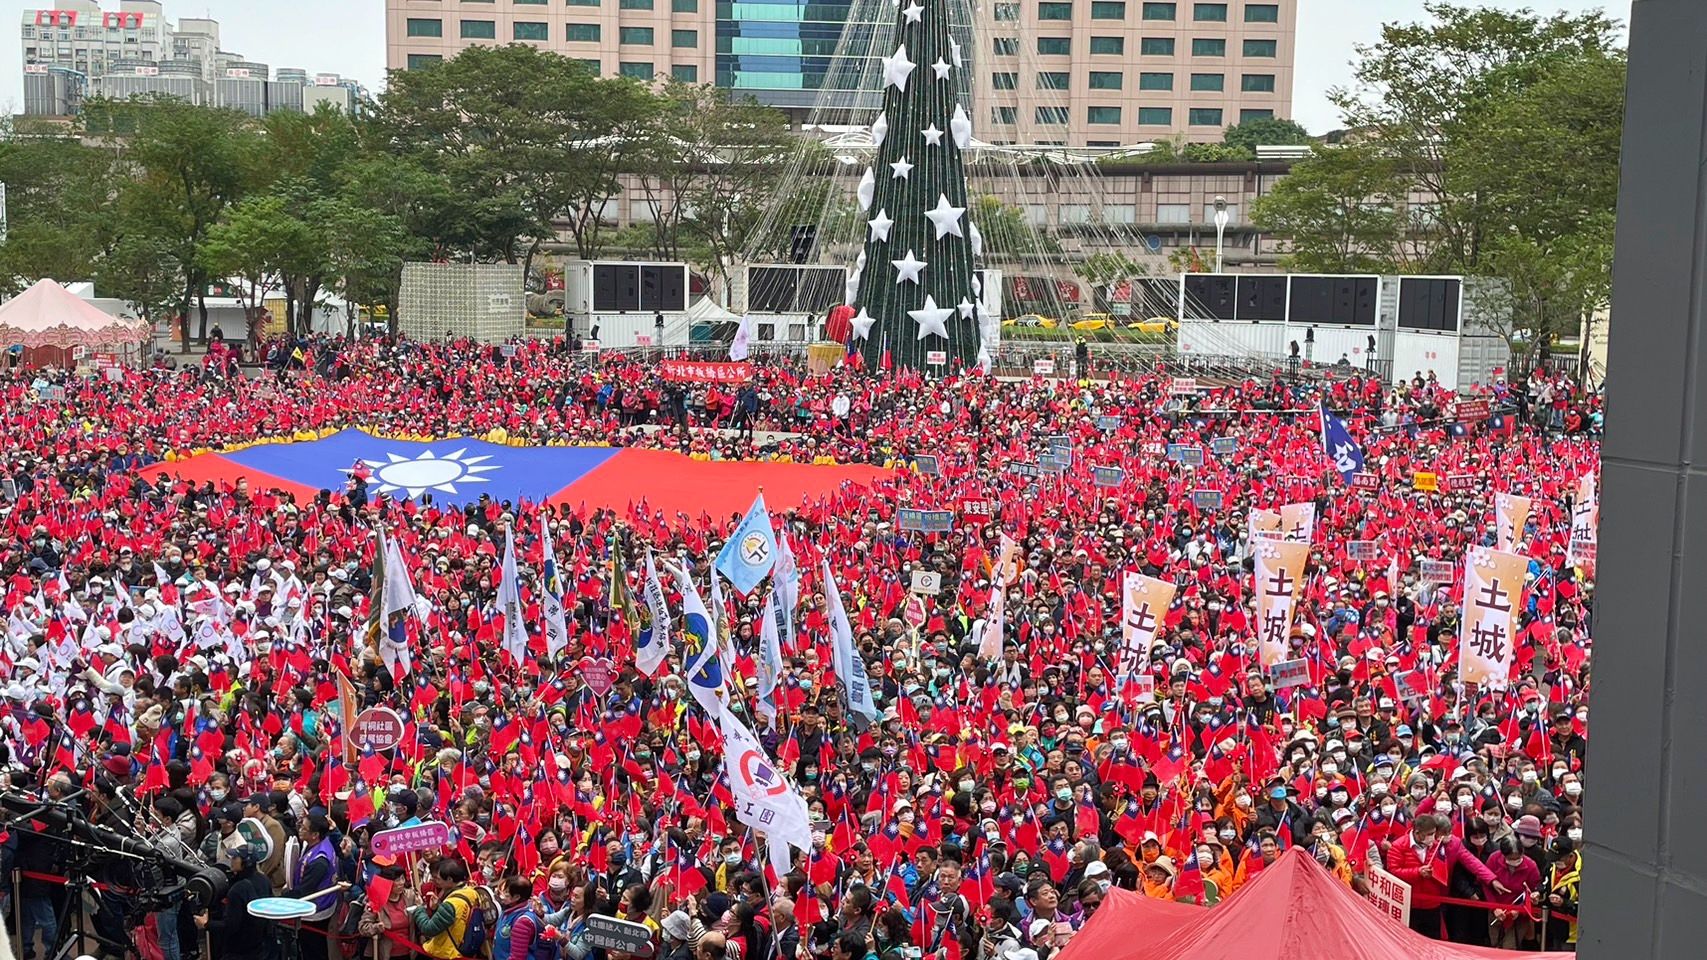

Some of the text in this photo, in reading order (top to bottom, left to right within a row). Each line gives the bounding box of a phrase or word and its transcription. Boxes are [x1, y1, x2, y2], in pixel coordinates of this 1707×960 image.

[665, 365, 747, 379] 新北市板橋區公所
[963, 501, 989, 515] 東安里
[1263, 568, 1294, 645] 土城
[1470, 578, 1512, 664] 土城
[1121, 602, 1156, 673] 土城
[1367, 870, 1405, 905] 中和區
[589, 919, 621, 933] 社團法人
[584, 932, 636, 953] 中醫師公會
